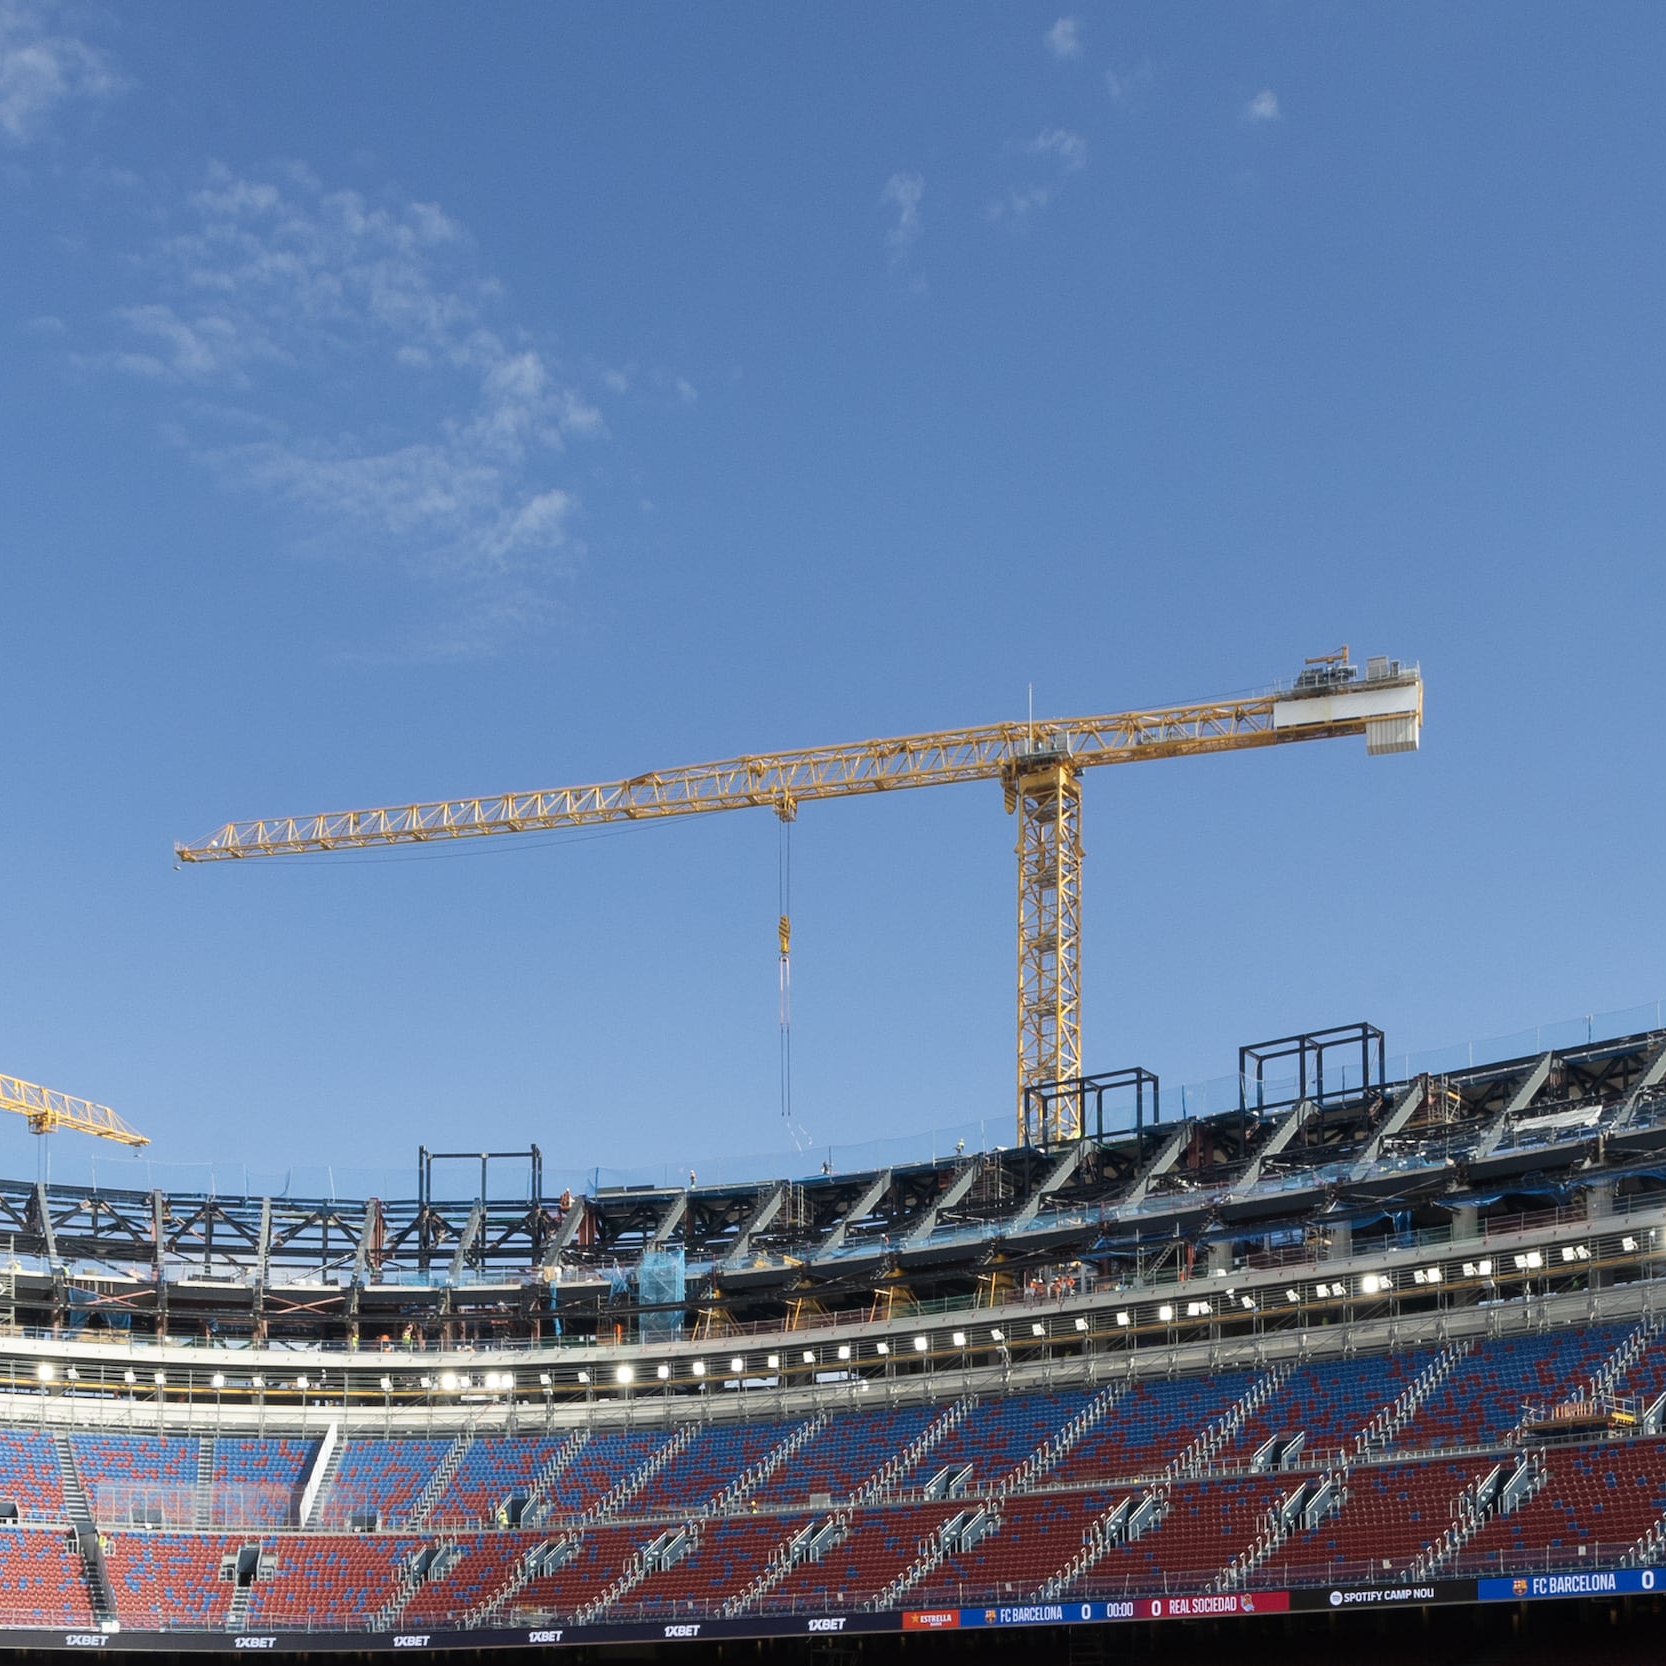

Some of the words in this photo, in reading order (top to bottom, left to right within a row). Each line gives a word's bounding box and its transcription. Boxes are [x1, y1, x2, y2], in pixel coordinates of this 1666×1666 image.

[1533, 1577, 1547, 1594] FC
[1548, 1573, 1616, 1593] BARCELONA
[1641, 1570, 1655, 1589] 0
[1343, 1591, 1383, 1602] SPOTIFY
[1383, 1589, 1412, 1600] CAMP
[1413, 1588, 1434, 1598] NOU
[1000, 1609, 1011, 1622] FC
[1012, 1606, 1063, 1621] BARCELONA
[1080, 1604, 1092, 1620] 0
[1107, 1602, 1134, 1618] 00:00
[1151, 1600, 1162, 1616] 0
[1169, 1598, 1191, 1615] REAL
[1191, 1596, 1237, 1612] SOCIEDAD
[807, 1617, 847, 1632] 1XBET
[920, 1614, 952, 1623] ESTRELLA
[528, 1630, 563, 1643] 1XBET
[664, 1625, 700, 1638] 1XBET
[65, 1635, 109, 1647] 1XBET
[234, 1637, 277, 1649] 1XBET
[393, 1635, 430, 1648] 1XBET
